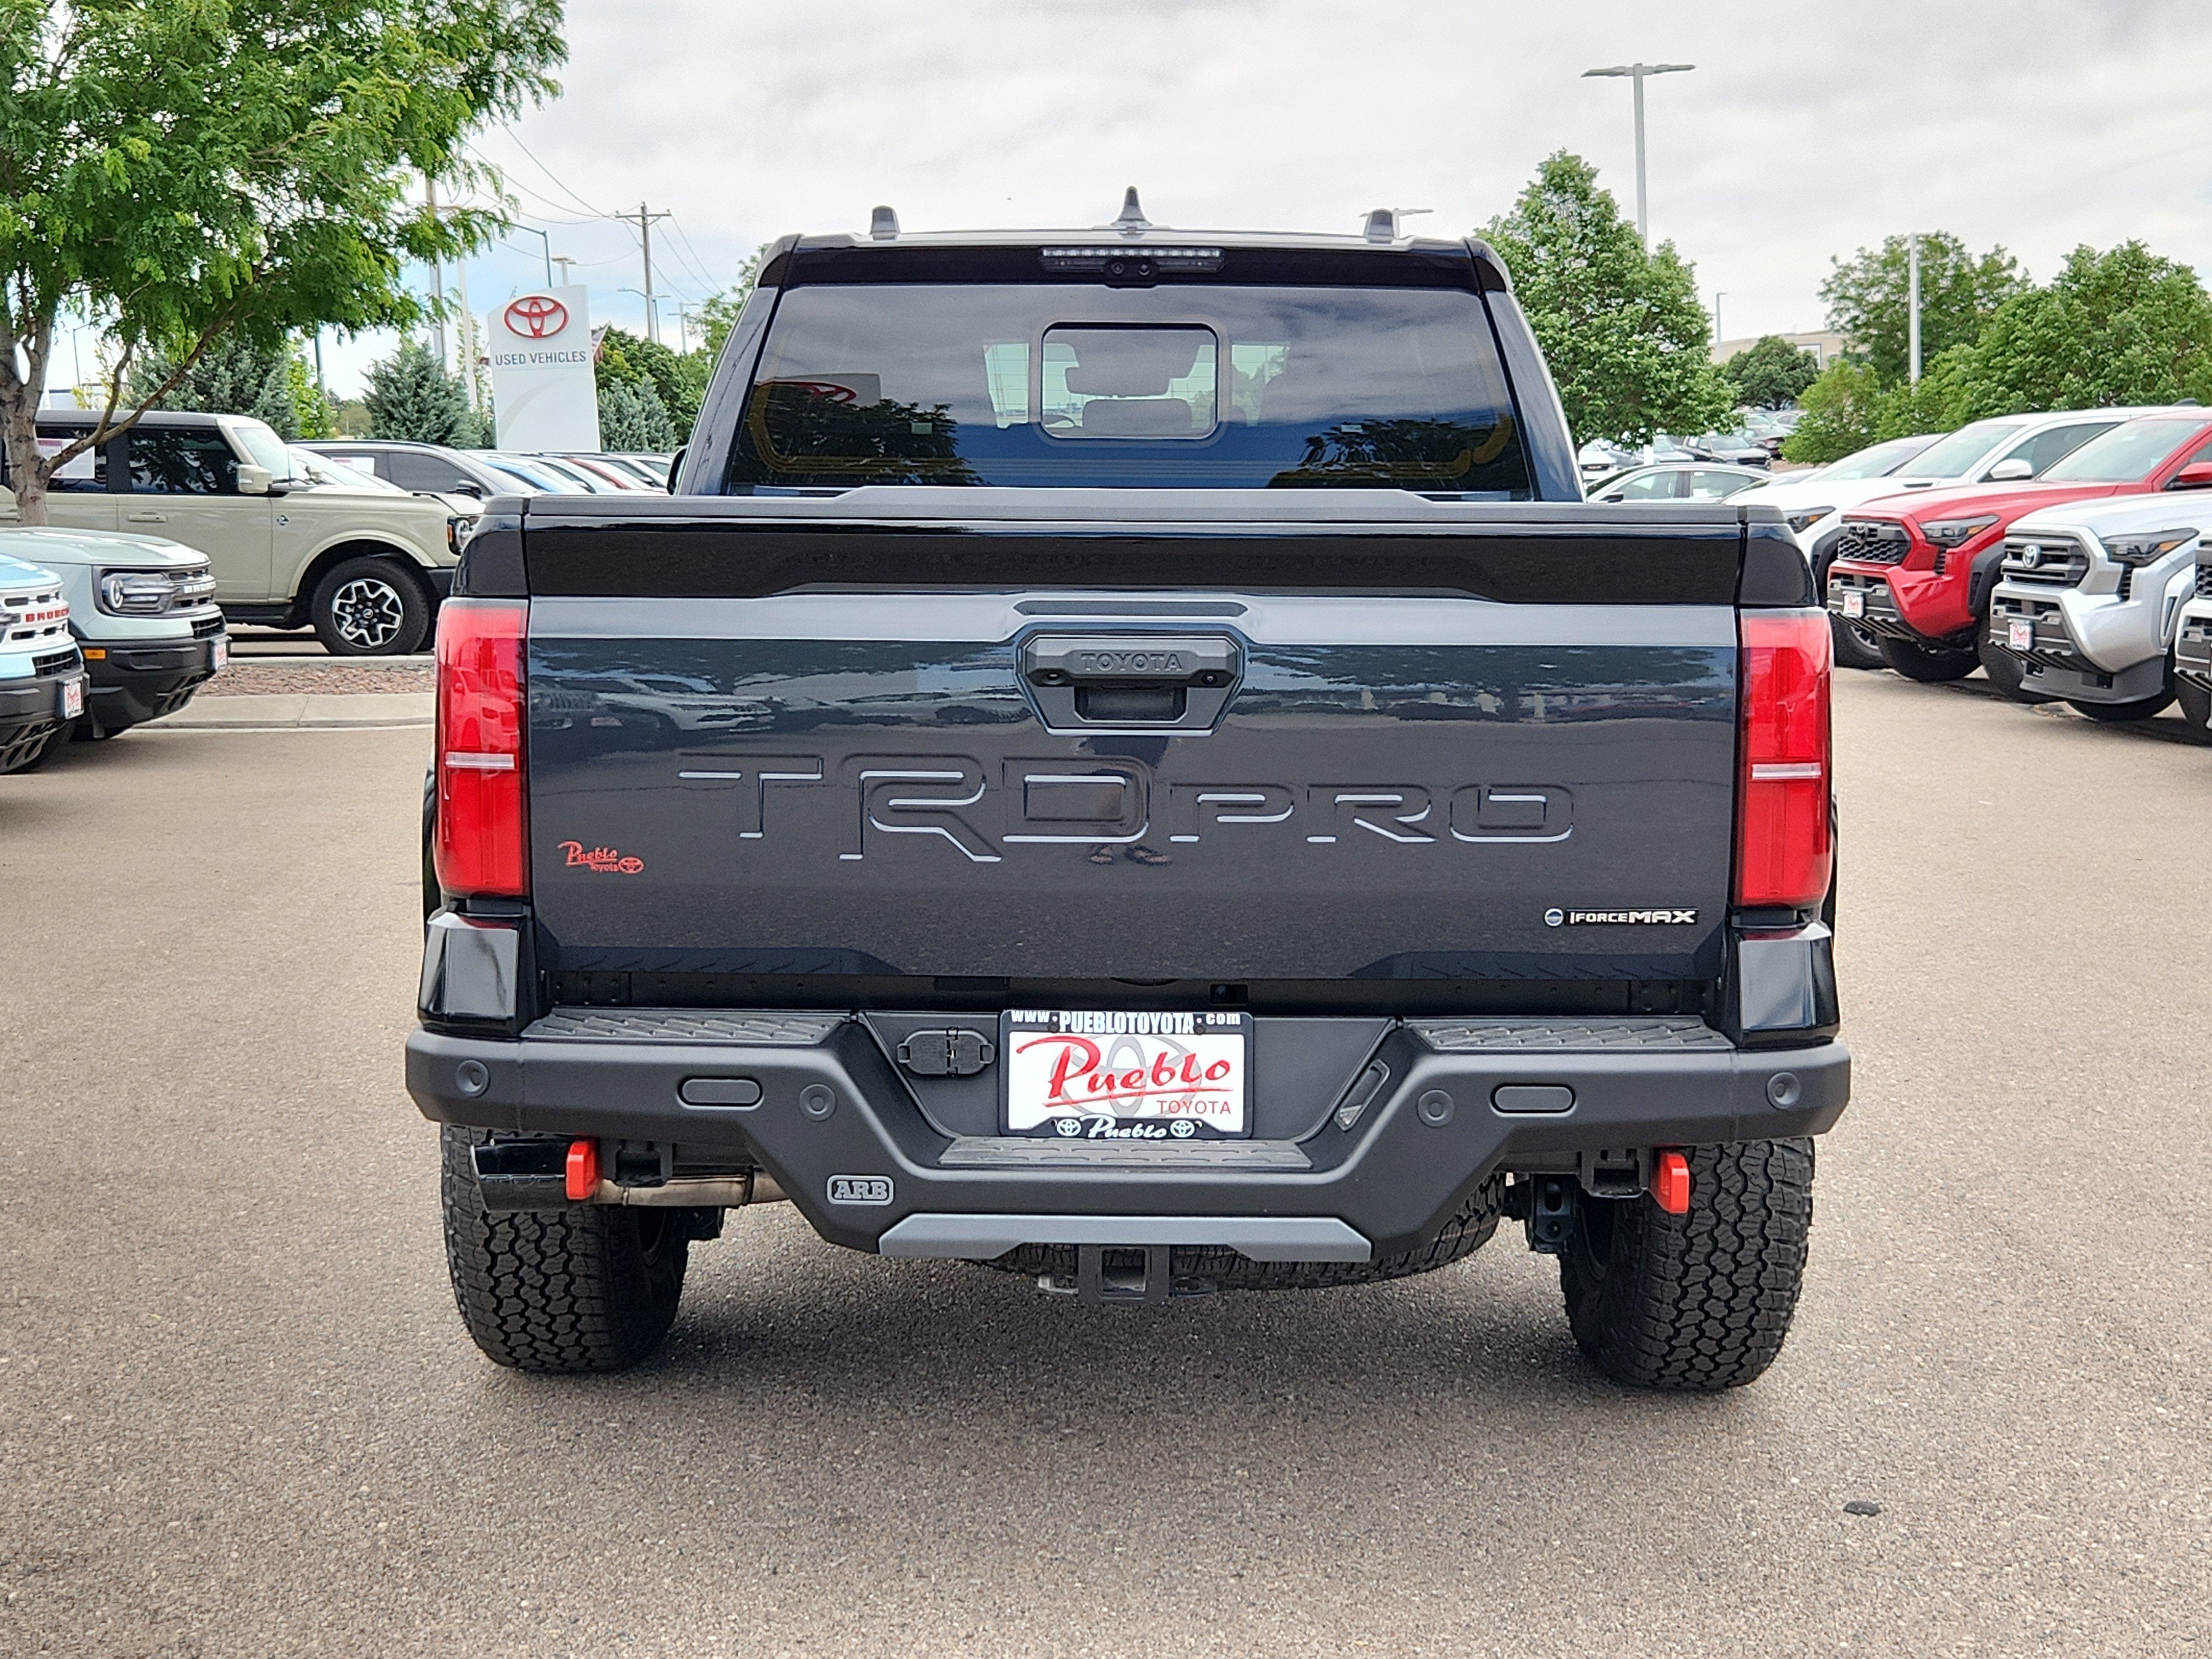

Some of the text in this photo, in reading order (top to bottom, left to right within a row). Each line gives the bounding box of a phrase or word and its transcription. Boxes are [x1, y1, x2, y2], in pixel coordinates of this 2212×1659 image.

[496, 351, 587, 365] USED VEHICLES
[1081, 653, 1182, 672] TOYOTA
[678, 751, 1574, 862] TRD PRO
[557, 840, 618, 864] Pueblo
[1016, 1035, 1231, 1099] Pueblo
[1156, 1100, 1232, 1115] TOYOTA
[1080, 1114, 1167, 1139] Pueblo
[834, 1181, 888, 1199] ARB
